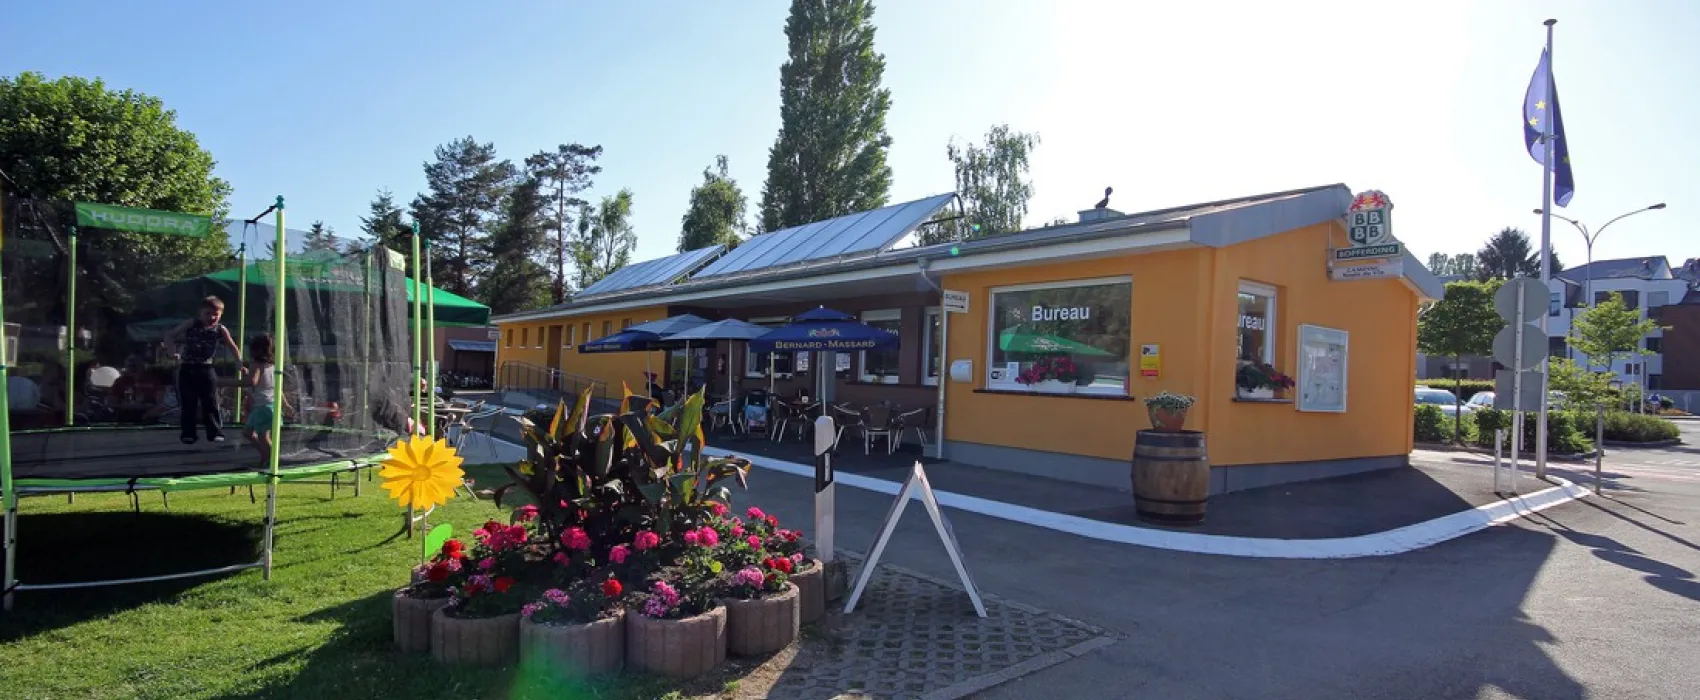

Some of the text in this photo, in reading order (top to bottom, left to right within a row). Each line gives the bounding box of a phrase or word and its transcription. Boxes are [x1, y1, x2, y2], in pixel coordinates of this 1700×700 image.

[1355, 211, 1380, 225] B B
[1355, 226, 1380, 240] B B
[1338, 246, 1396, 258] BOFFERDING
[1031, 306, 1091, 321] Bureau
